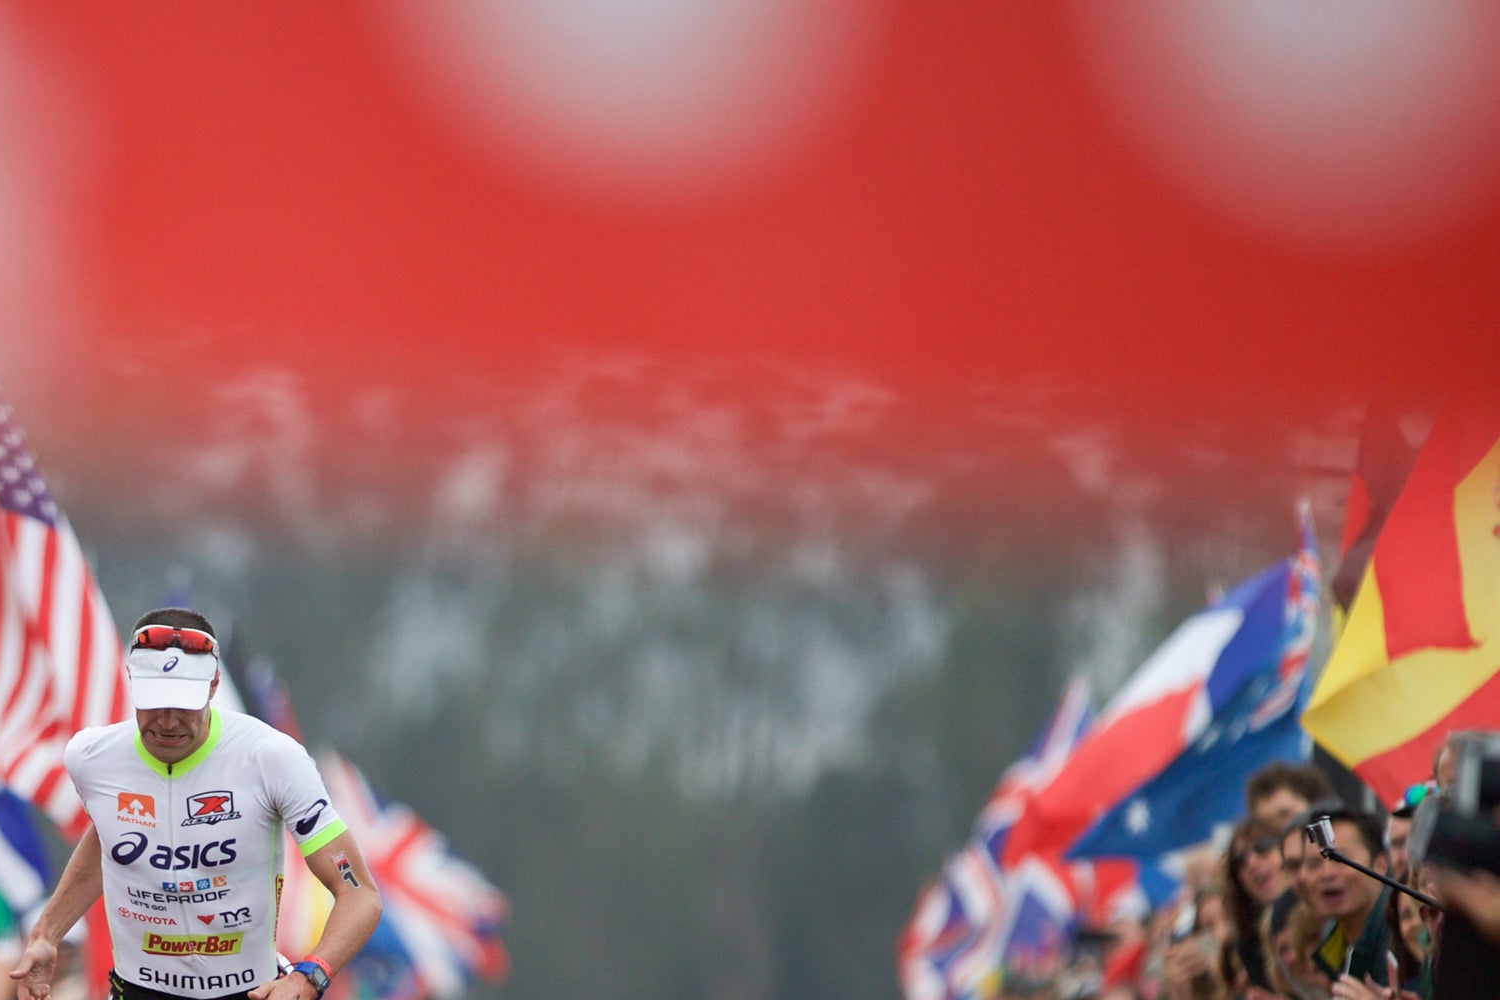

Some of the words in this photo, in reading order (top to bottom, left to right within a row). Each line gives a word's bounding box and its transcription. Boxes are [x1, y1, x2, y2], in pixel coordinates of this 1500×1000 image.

[116, 815, 157, 828] NATHAN
[182, 811, 241, 827] KESTREL
[342, 870, 361, 888] 1
[127, 886, 231, 905] LIFEPROOF
[132, 912, 177, 927] TOYOTA
[219, 906, 252, 924] TYR
[147, 933, 239, 954] PowerBar
[138, 967, 255, 990] SHIMANO
